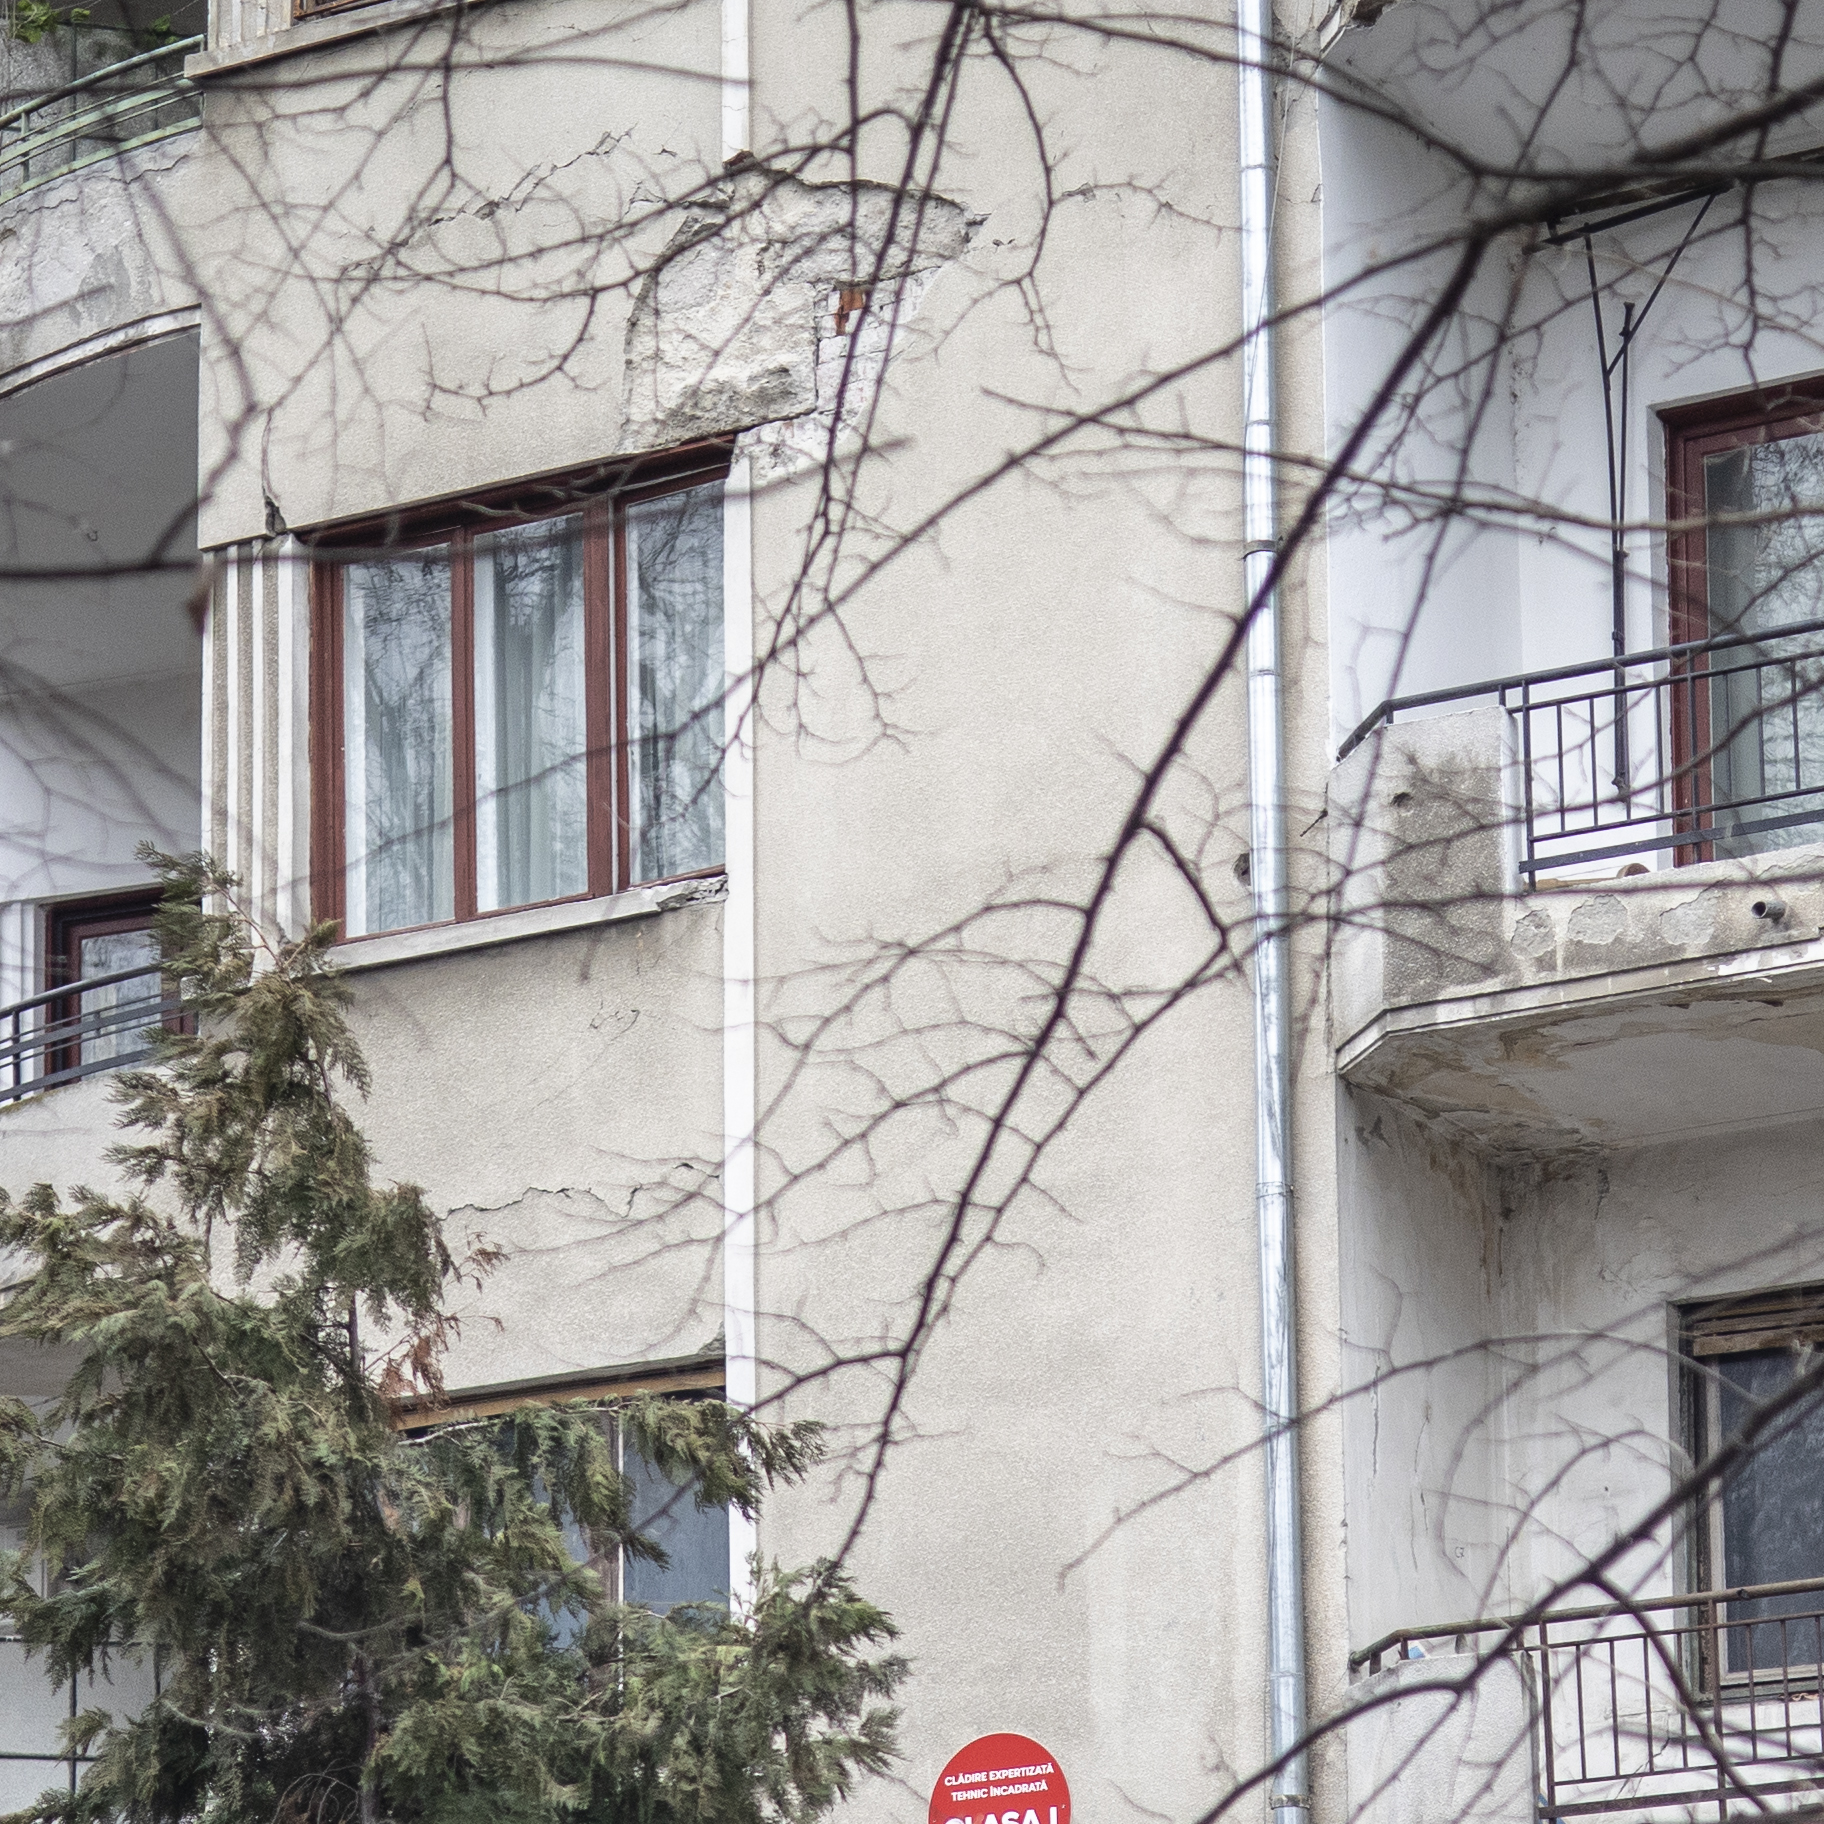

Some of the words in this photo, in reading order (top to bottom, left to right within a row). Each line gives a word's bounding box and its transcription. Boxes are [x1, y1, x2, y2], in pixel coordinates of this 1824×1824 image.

[944, 1772, 988, 1786] CLĂDIRE
[989, 1763, 1054, 1781] EXPERTIZATĂ
[951, 1787, 989, 1802] TEHNIC
[990, 1780, 1048, 1797] ÎNCADRATĂ
